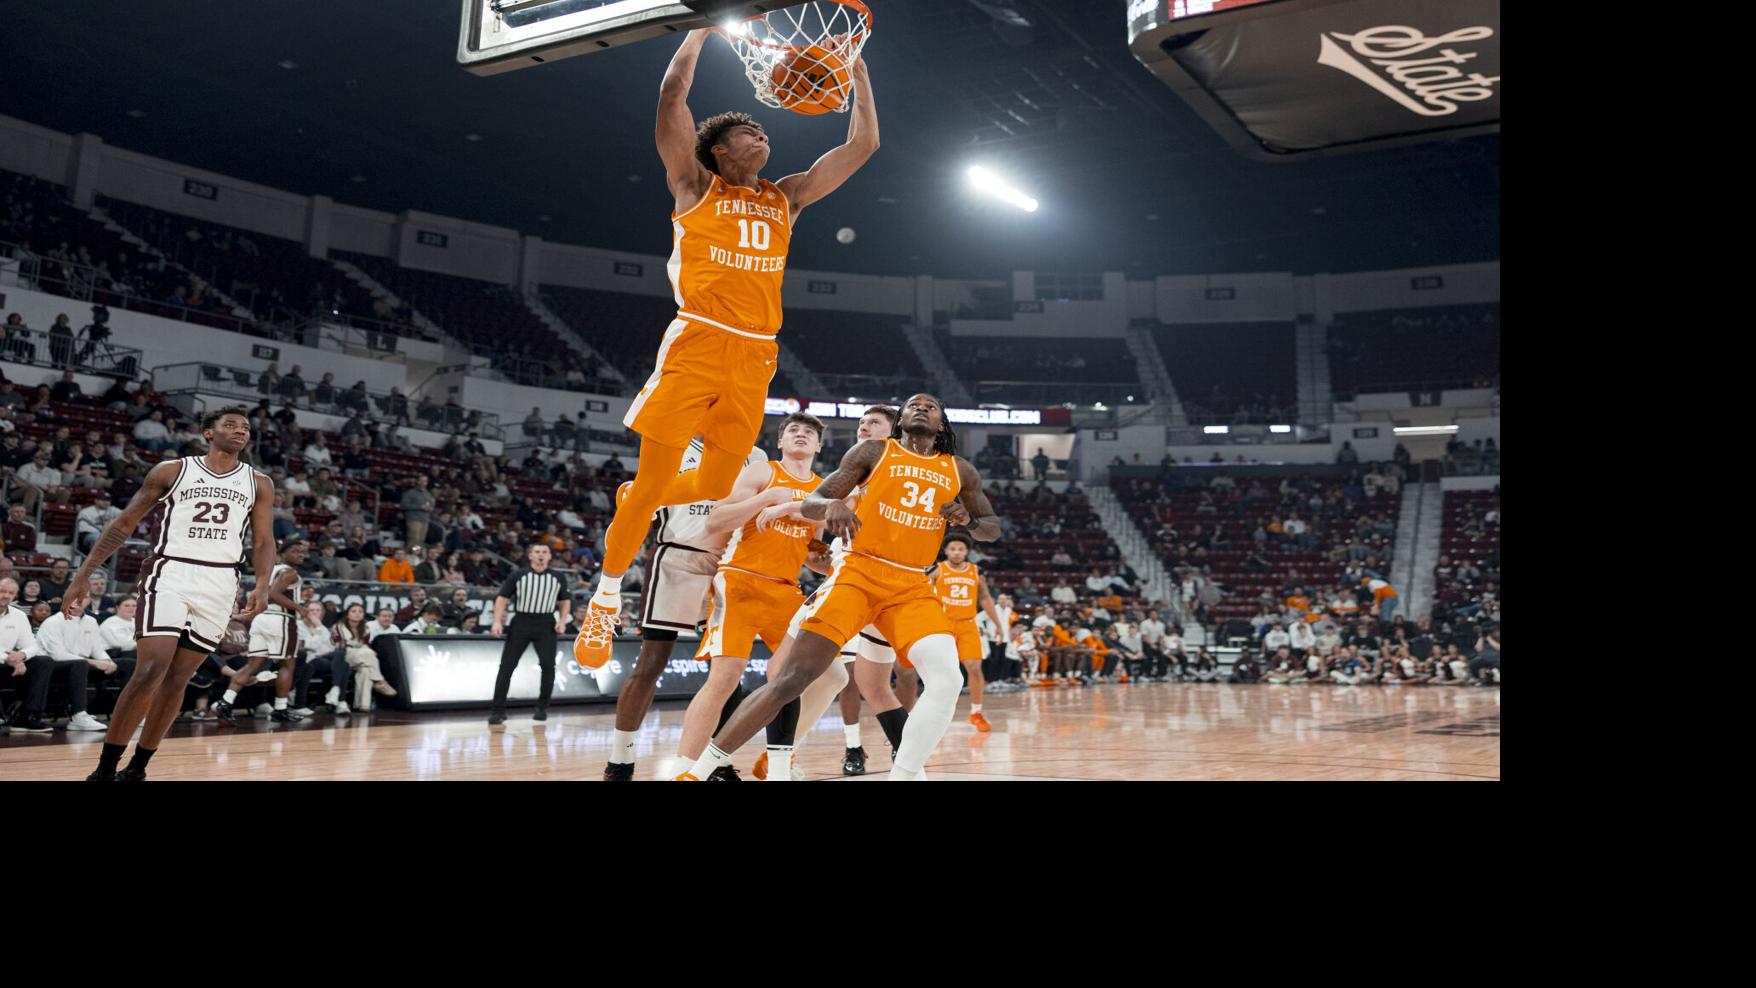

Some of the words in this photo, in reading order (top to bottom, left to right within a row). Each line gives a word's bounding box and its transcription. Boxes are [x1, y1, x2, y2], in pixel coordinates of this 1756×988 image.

[1317, 25, 1500, 115] State
[738, 218, 770, 250] 10
[889, 465, 951, 490] TENNESSEE
[180, 486, 248, 508] MISSISSIPPI
[900, 481, 936, 513] 34
[192, 501, 230, 524] 23
[689, 504, 714, 516] STA
[878, 502, 944, 530] VOLUNTEERS
[188, 527, 228, 540] STATE
[950, 585, 968, 598] 24
